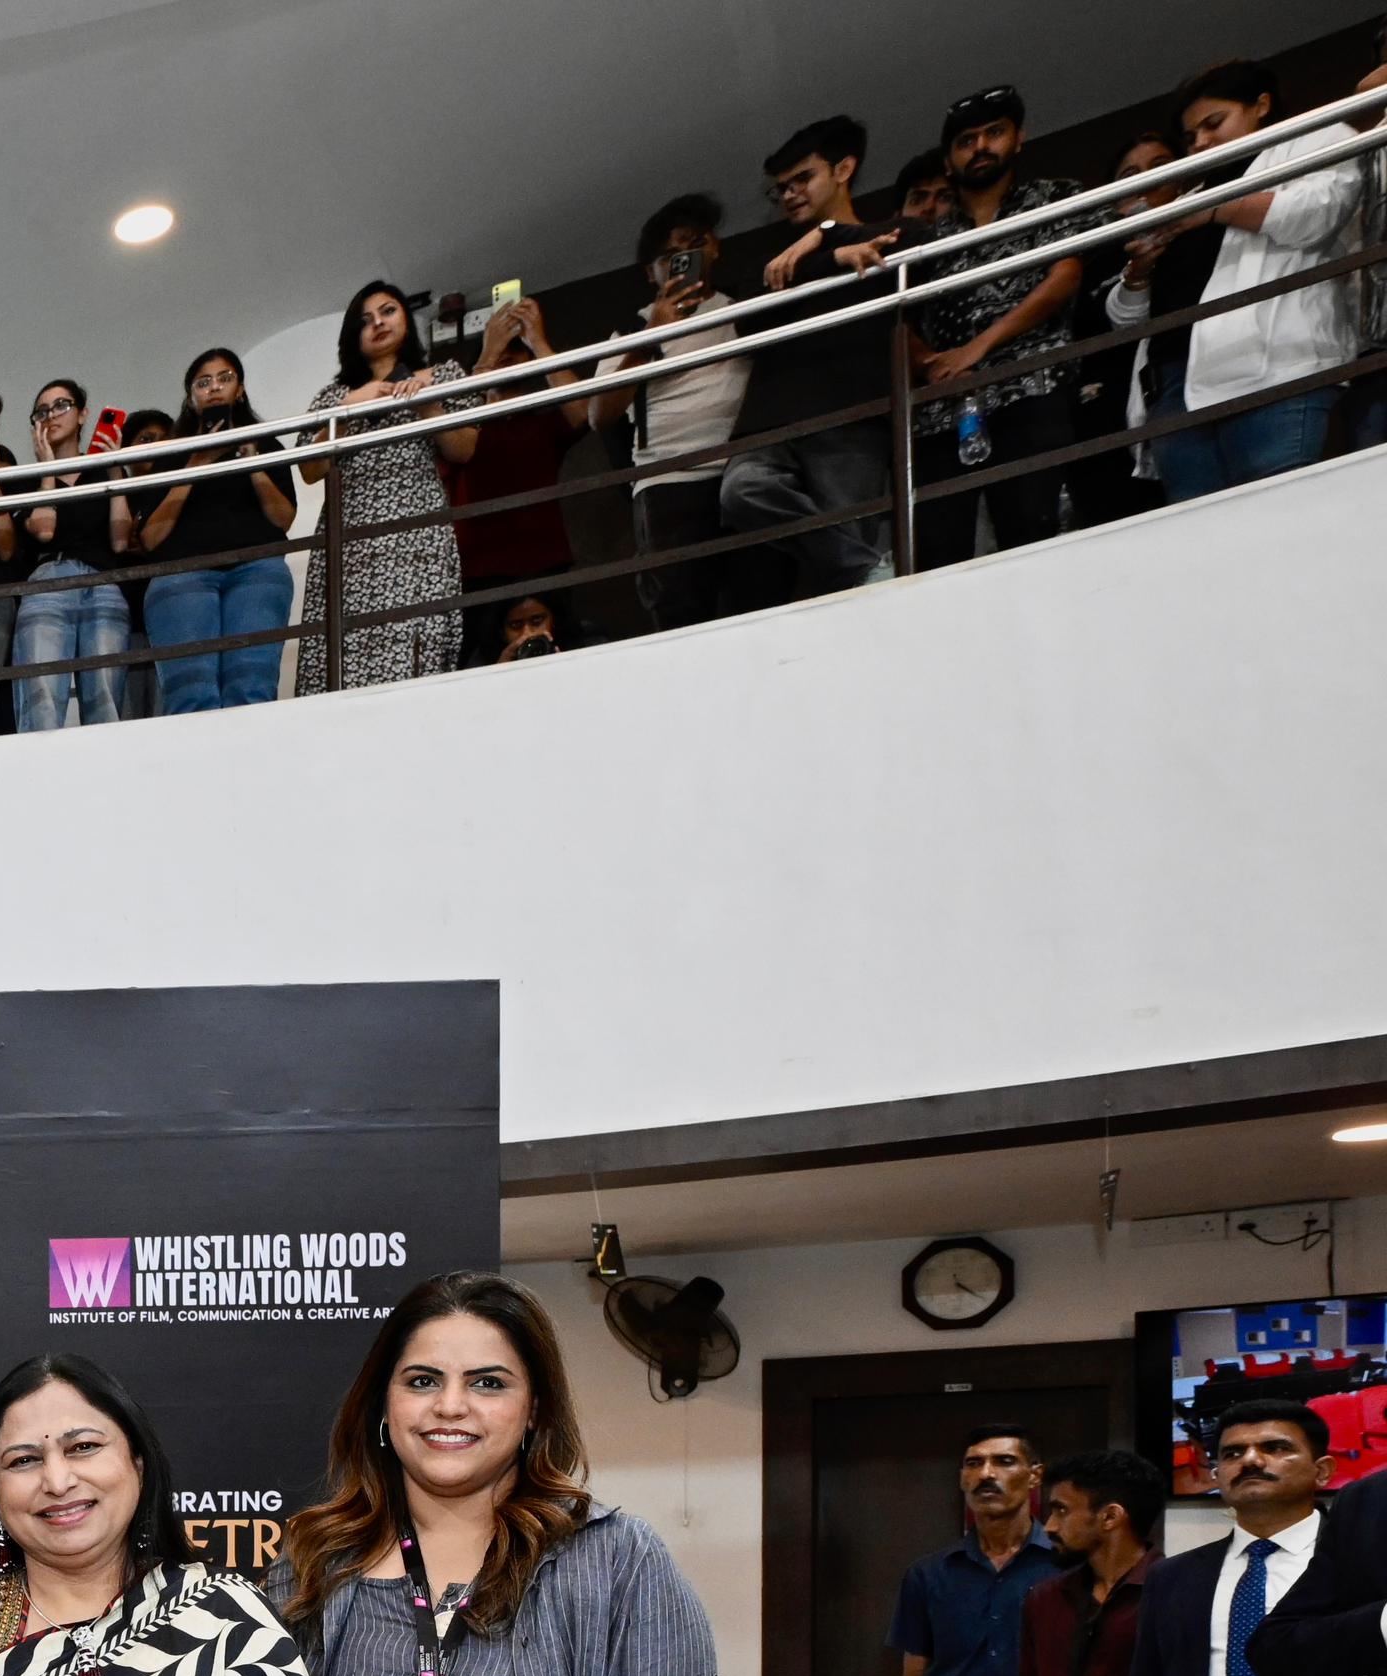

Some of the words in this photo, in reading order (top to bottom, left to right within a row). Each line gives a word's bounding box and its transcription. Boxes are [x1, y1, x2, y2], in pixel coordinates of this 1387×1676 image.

[135, 1235, 291, 1271] WHISTLING
[301, 1232, 407, 1268] WOODS
[135, 1268, 359, 1307] INTERNATIONAL
[49, 1312, 115, 1324] INSTITUTE
[118, 1311, 137, 1323] OF
[140, 1311, 173, 1324] FILM,
[177, 1308, 291, 1322] COMMUNICATION
[294, 1308, 304, 1320] &
[307, 1307, 370, 1320] CREATIVE
